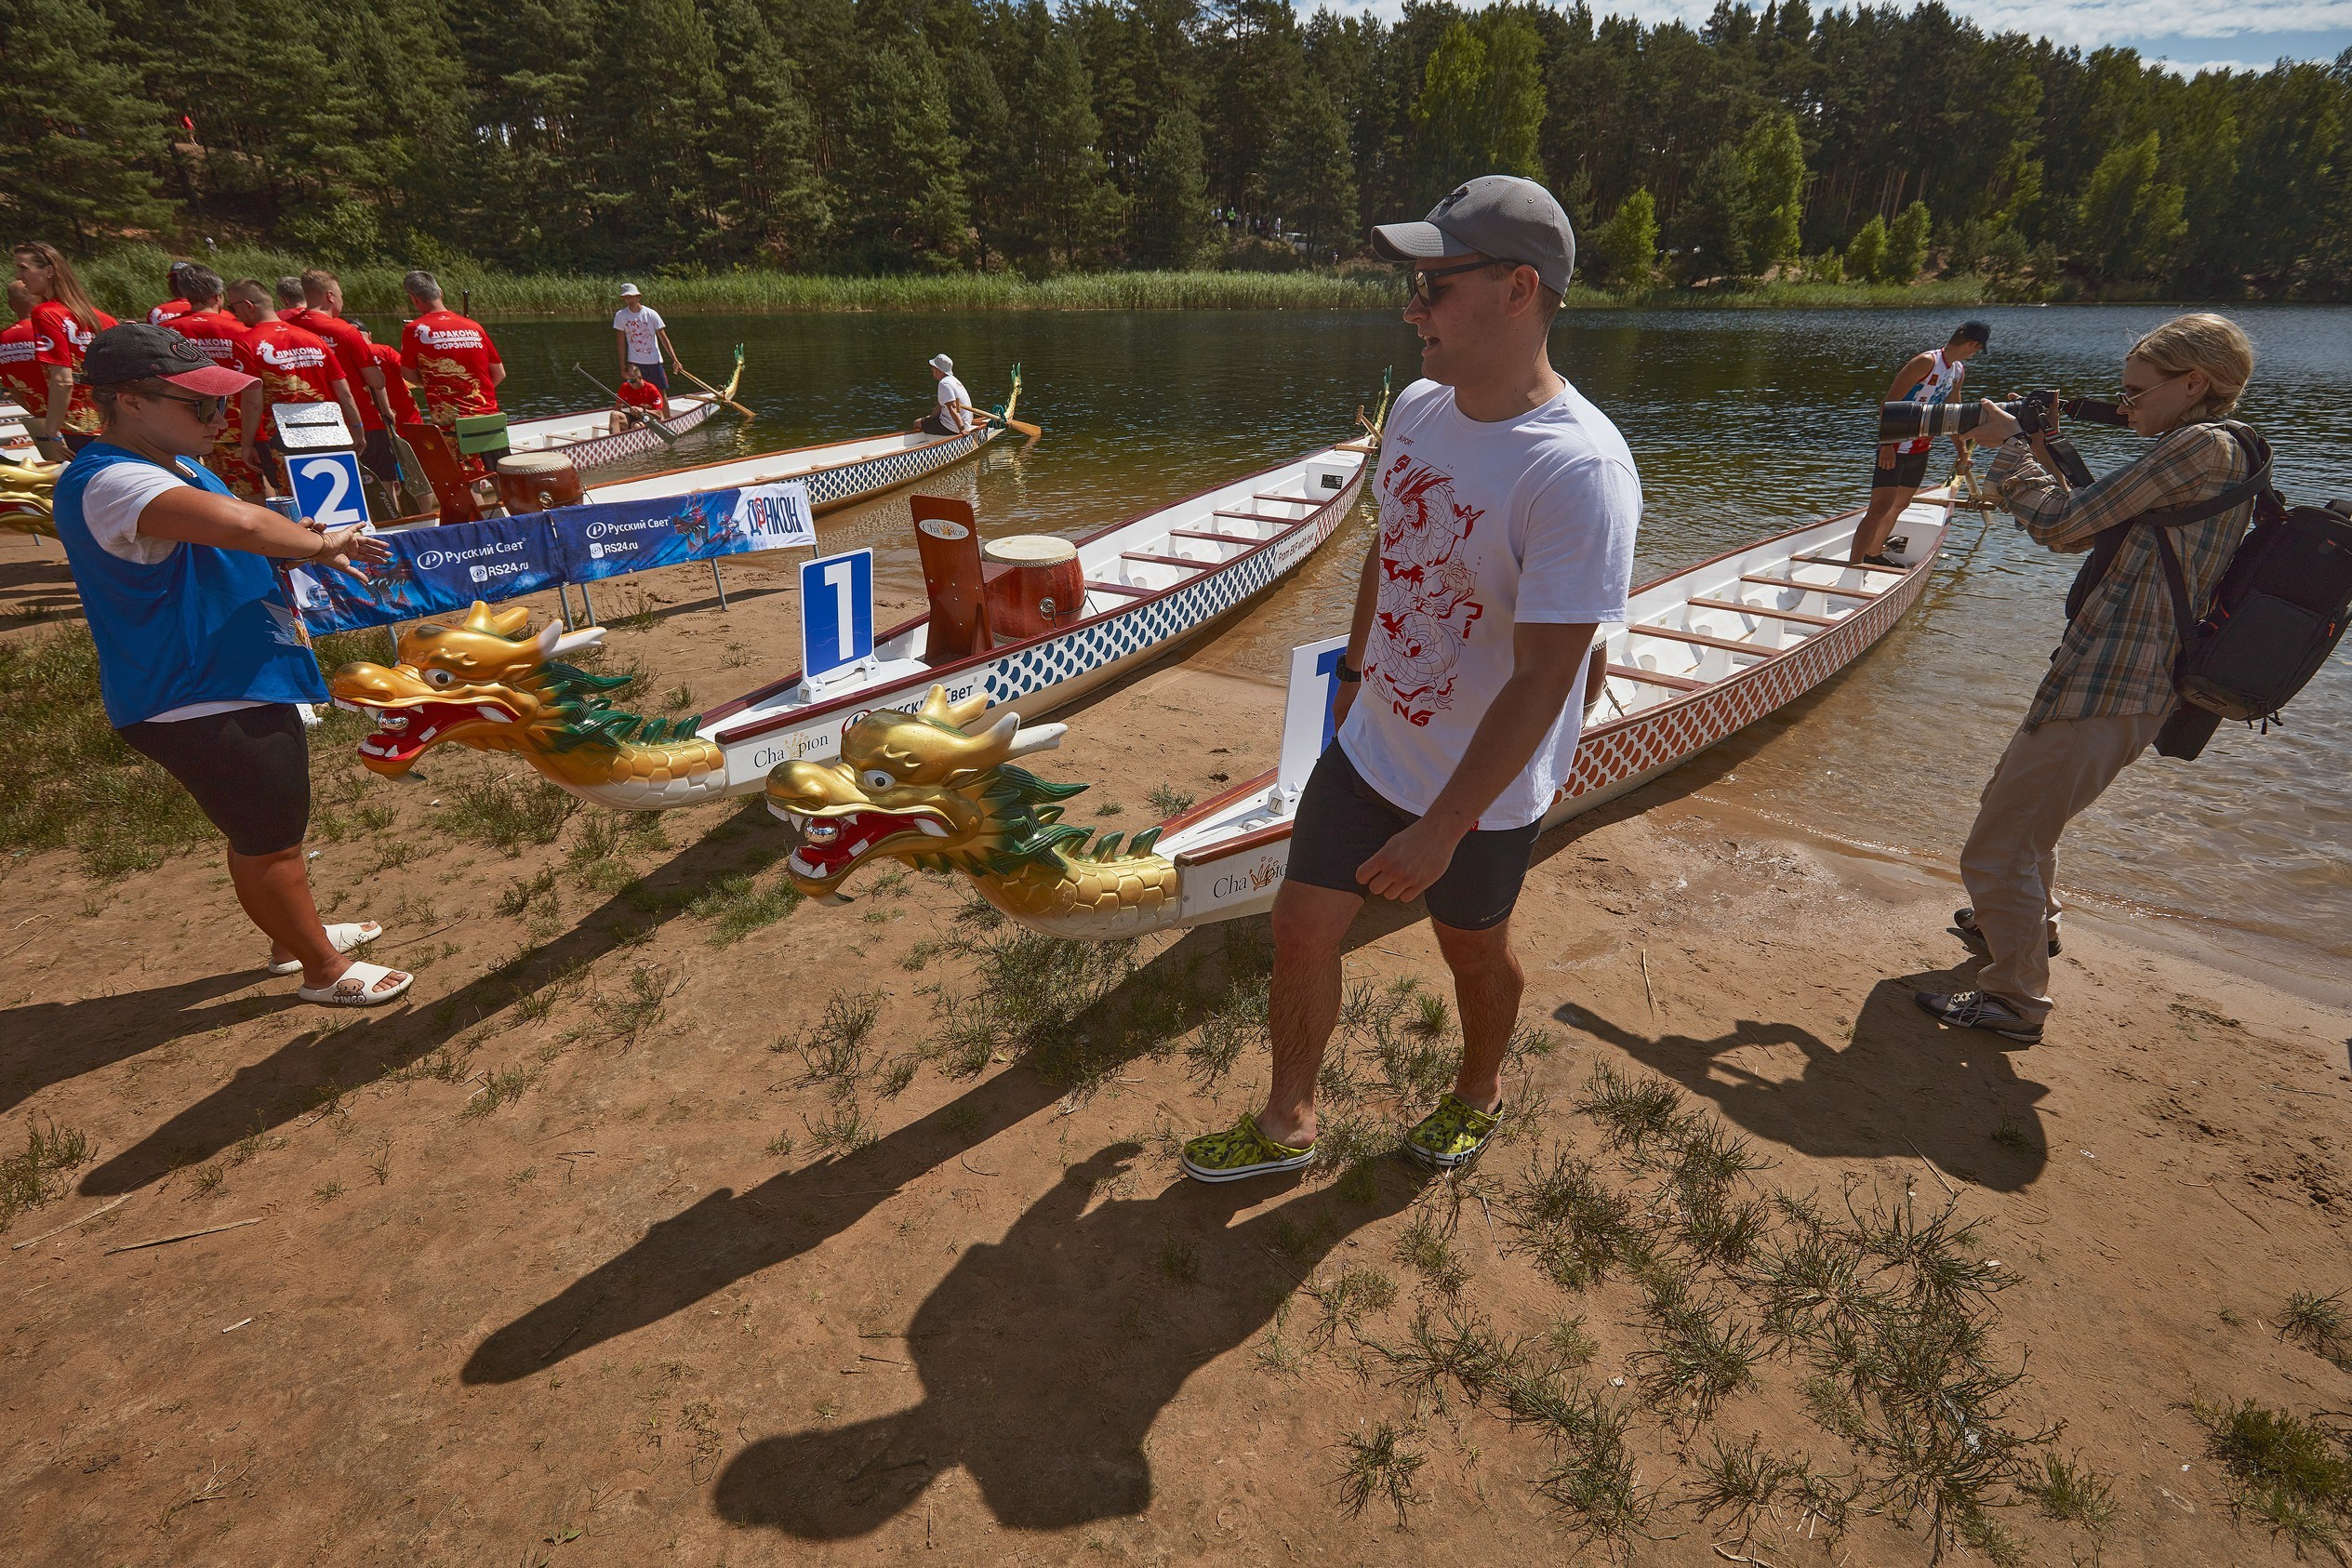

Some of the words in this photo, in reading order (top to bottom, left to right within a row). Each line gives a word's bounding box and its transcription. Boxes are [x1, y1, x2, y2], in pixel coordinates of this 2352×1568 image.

[431, 329, 481, 339] ДРАКОНЫ
[275, 347, 324, 359] ДРАКОНЫ
[300, 458, 360, 526] 2
[747, 497, 804, 537] ДРАКОН
[607, 519, 646, 535] Русский
[647, 518, 669, 528] Свет
[445, 543, 494, 564] Русский
[496, 540, 524, 553] Свет
[604, 541, 639, 553] RS24.ru
[487, 562, 529, 577] RS24.ru
[824, 560, 854, 661] 1
